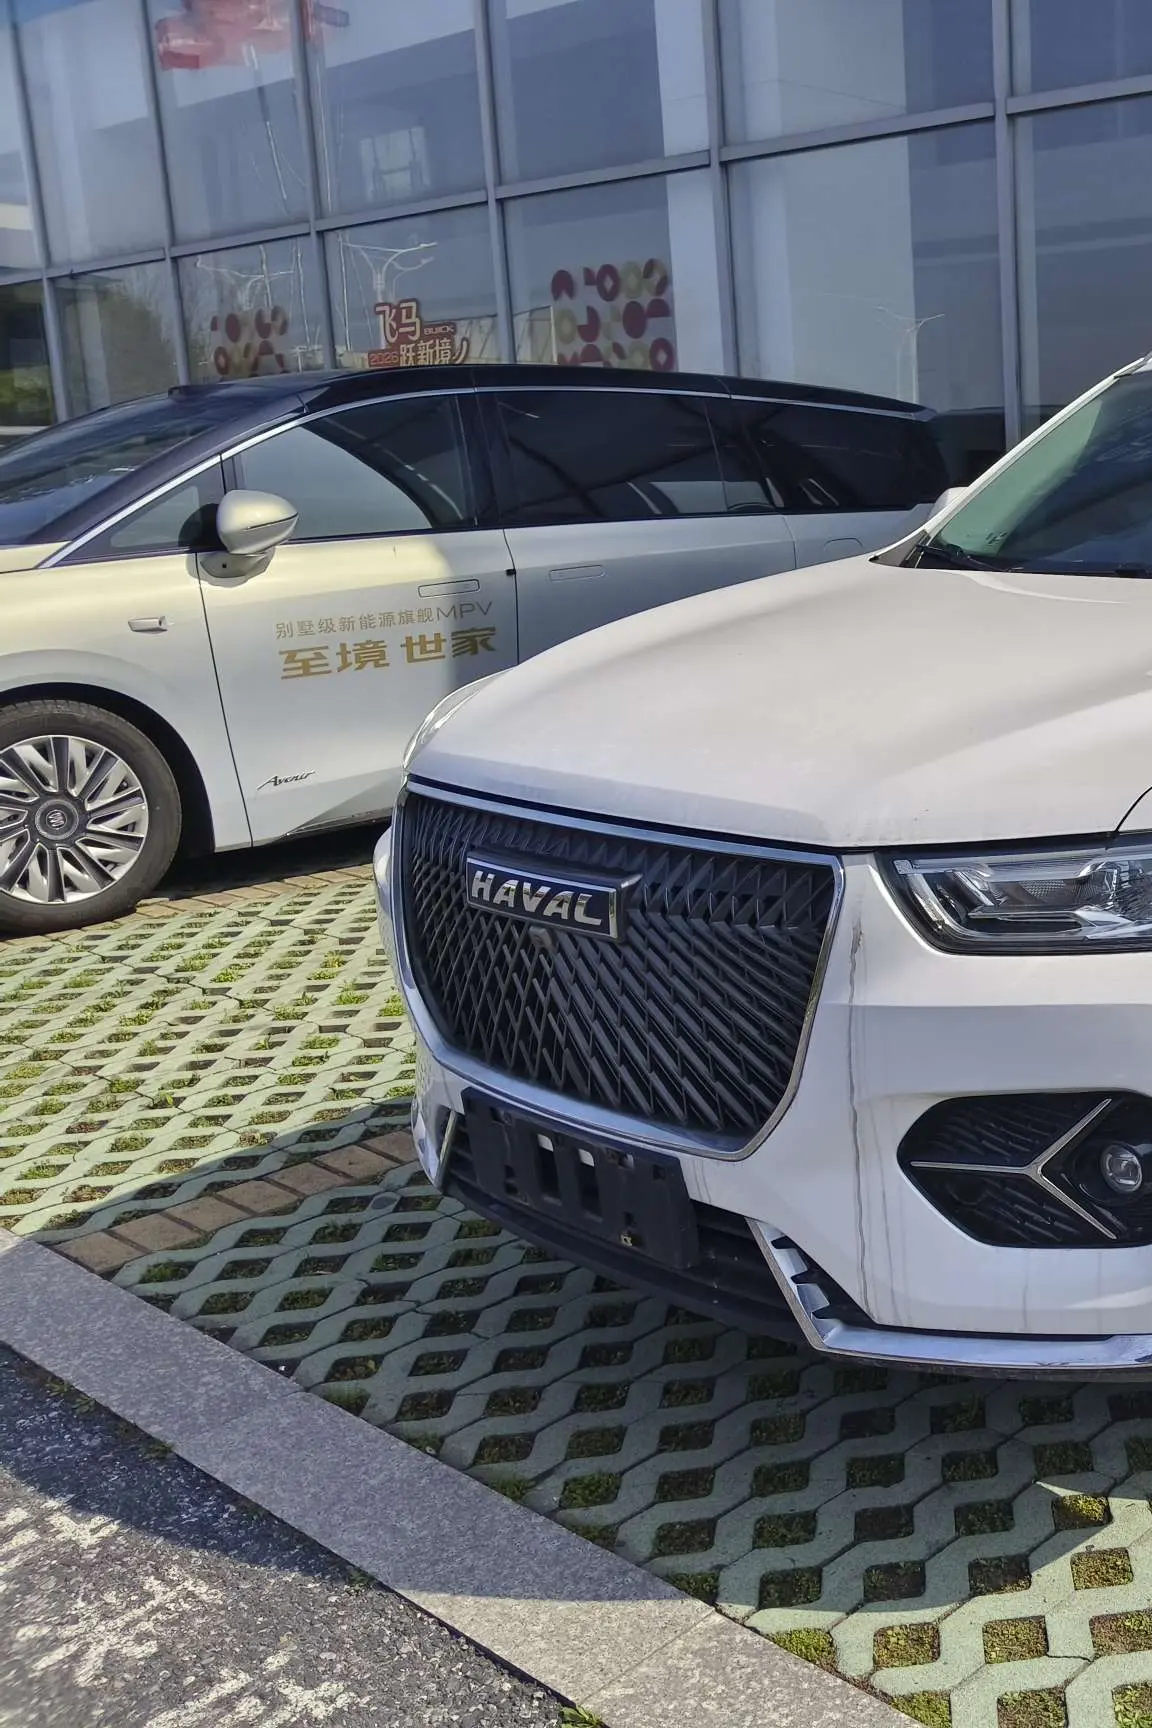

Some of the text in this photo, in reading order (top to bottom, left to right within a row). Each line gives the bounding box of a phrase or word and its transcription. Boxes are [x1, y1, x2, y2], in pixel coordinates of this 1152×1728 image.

[375, 301, 421, 343] 飞马
[423, 325, 455, 336] BUICK
[369, 338, 452, 367] 2026 跃新境
[275, 601, 493, 639] 别墅级新能源旗舰MPV
[471, 870, 602, 926] HAVAL
